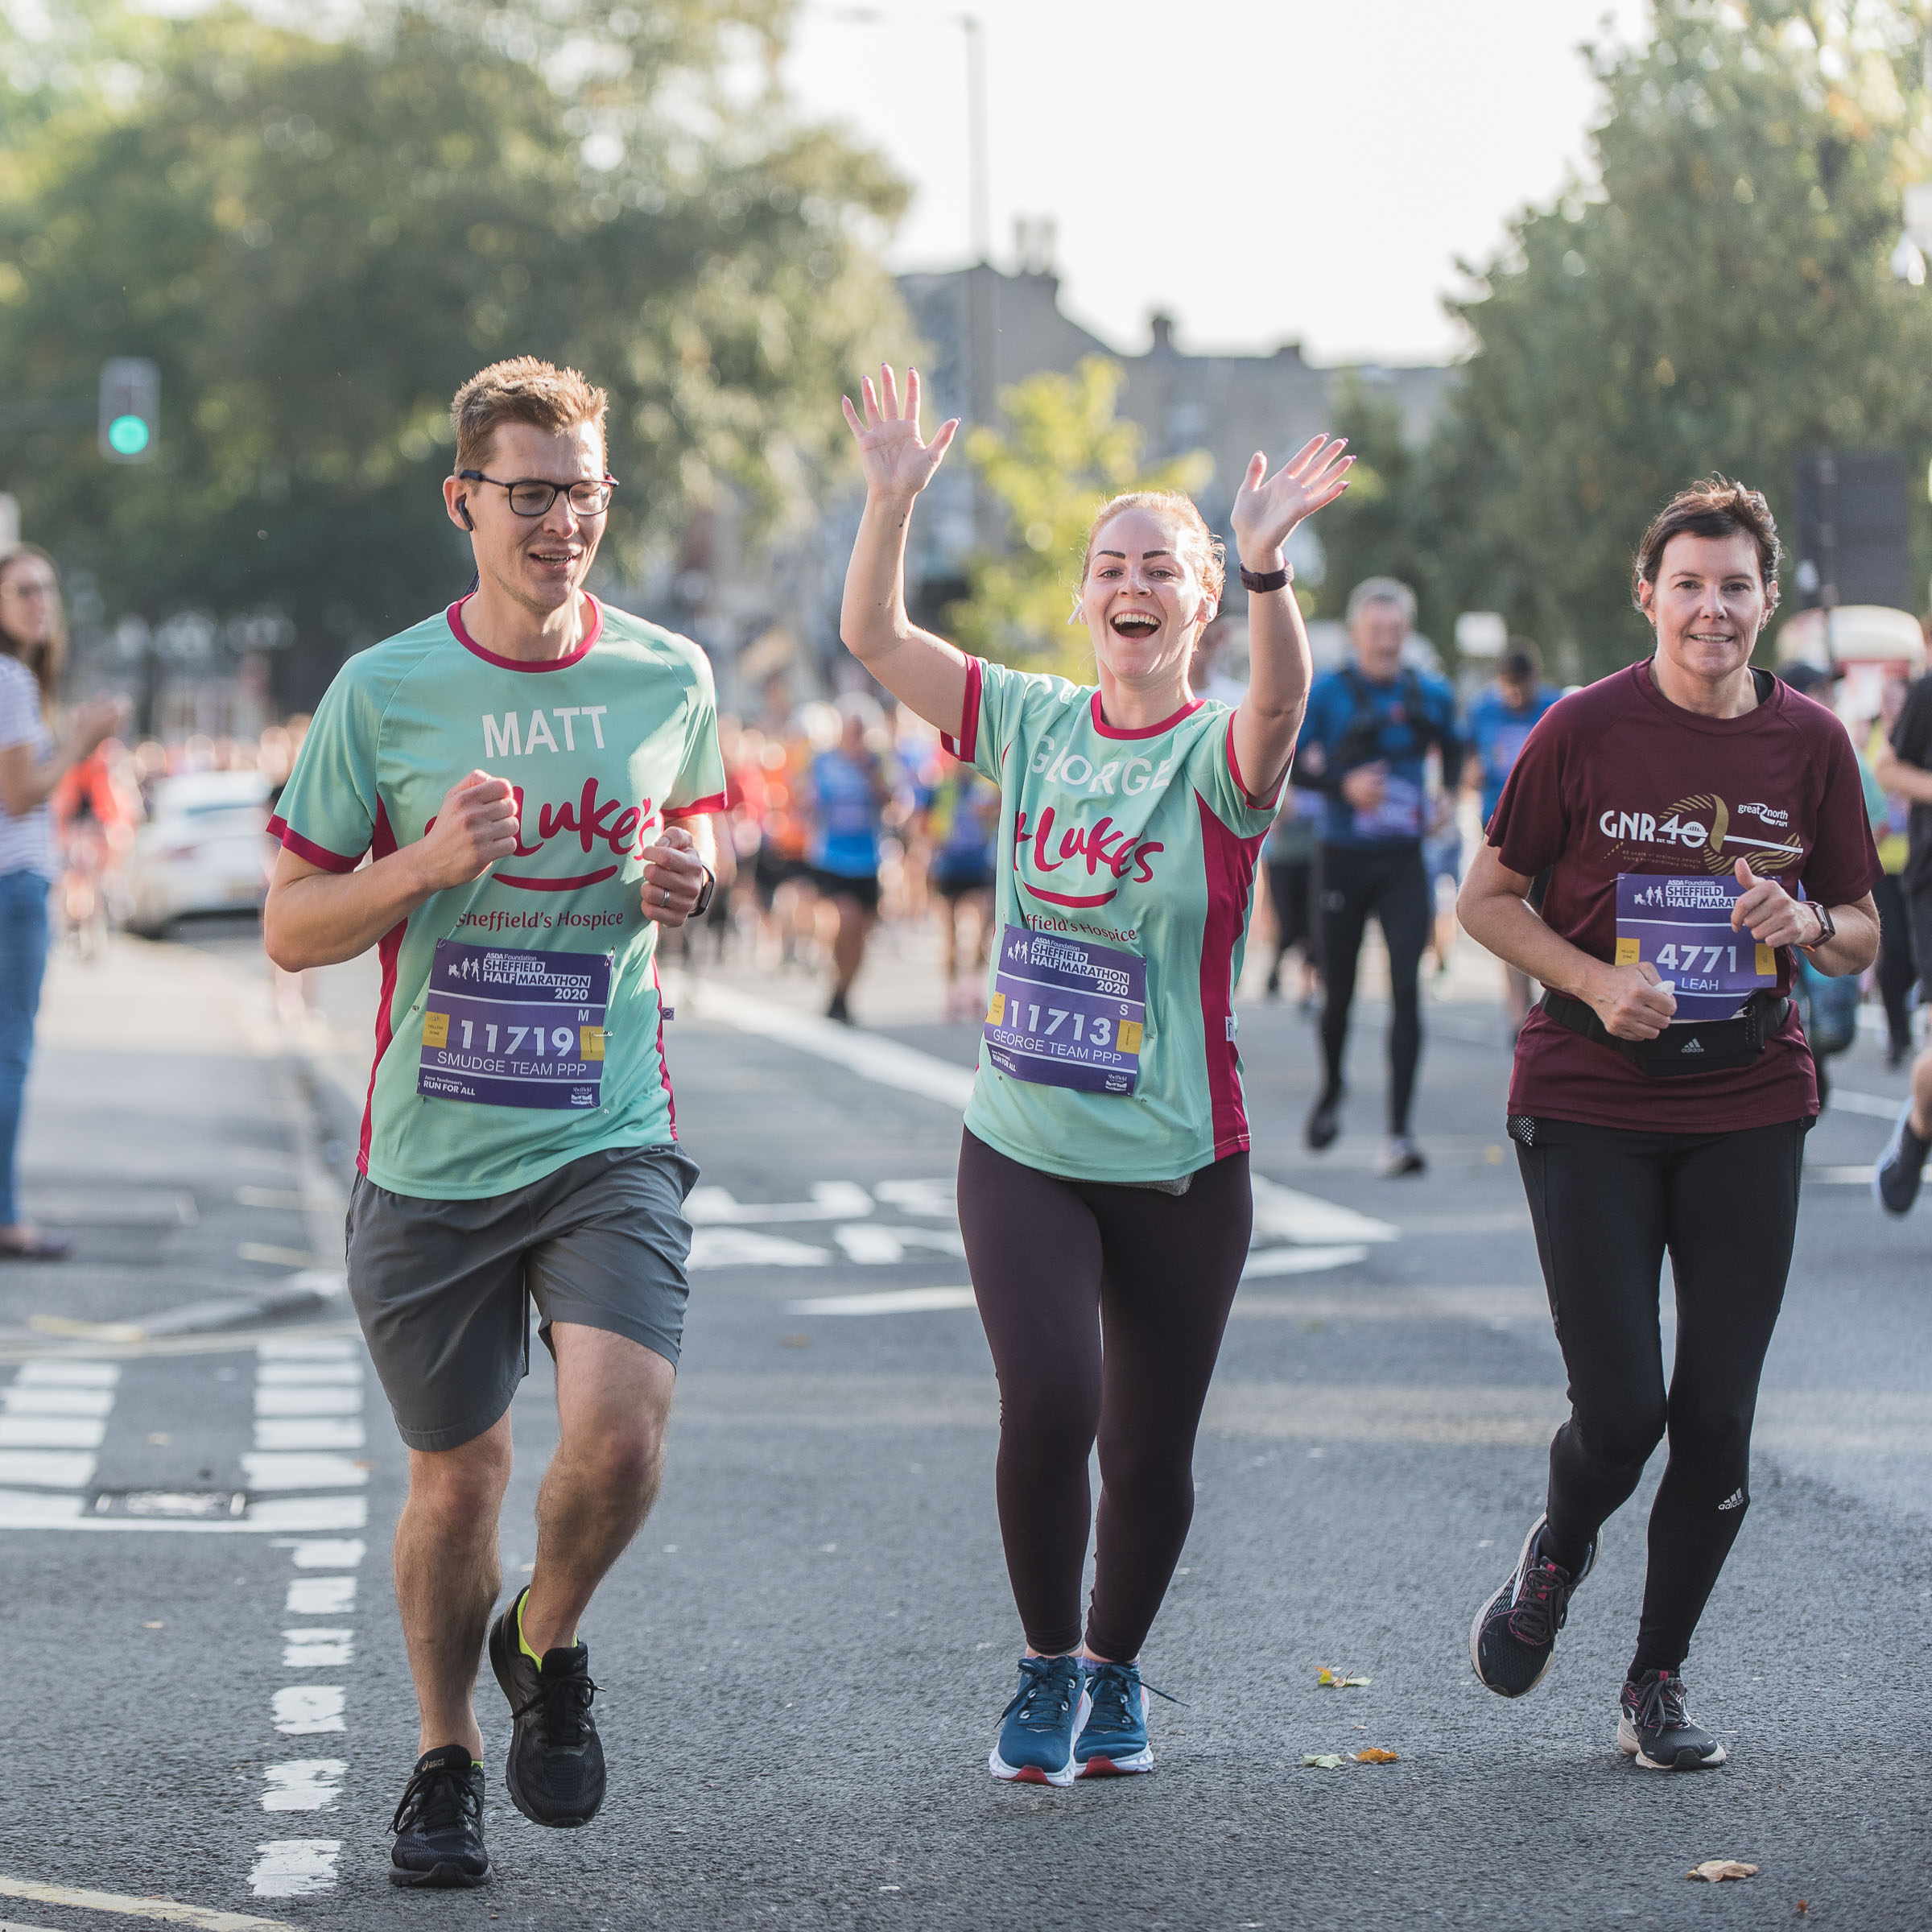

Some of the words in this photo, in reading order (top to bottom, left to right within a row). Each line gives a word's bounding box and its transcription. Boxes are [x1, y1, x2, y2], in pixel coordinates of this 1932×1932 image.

[481, 704, 608, 758] MATT
[1737, 804, 1761, 815] great
[1767, 809, 1788, 820] north
[1774, 819, 1787, 828] run
[1667, 886, 1722, 897] SHEFFIELD
[1667, 898, 1696, 908] HALF
[1699, 898, 1737, 908] MARAT
[456, 910, 552, 931] Sheffield's
[557, 910, 623, 931] Hospice
[1079, 923, 1137, 942] Hospice
[1034, 937, 1051, 945] ASDA
[1051, 940, 1080, 952] Foundation
[1032, 943, 1086, 963] SHEFFIELD
[1656, 943, 1736, 973] 4771
[485, 960, 543, 972] SHEFFIELD
[1030, 954, 1059, 969] HALF
[1060, 961, 1128, 984] MARATHON
[483, 971, 515, 984] HALF
[518, 973, 590, 987] MARATHON
[1681, 977, 1719, 991] LEAH
[555, 988, 588, 1001] 2020
[1096, 980, 1129, 996] 2020
[578, 1009, 589, 1022] M
[1119, 1004, 1129, 1017] S
[1010, 999, 1111, 1046] 11713
[460, 1019, 575, 1057] 11719
[993, 1028, 1045, 1052] GEORGE
[1049, 1041, 1088, 1060] TEAM
[1092, 1050, 1122, 1064] PPP
[437, 1051, 506, 1074] SMUDGE
[510, 1061, 552, 1076] TEAM
[557, 1063, 587, 1076] PPP
[423, 1080, 441, 1091] RUN
[442, 1084, 459, 1093] FOR
[460, 1087, 476, 1096] ALL
[1718, 1497, 1744, 1510] adidas
